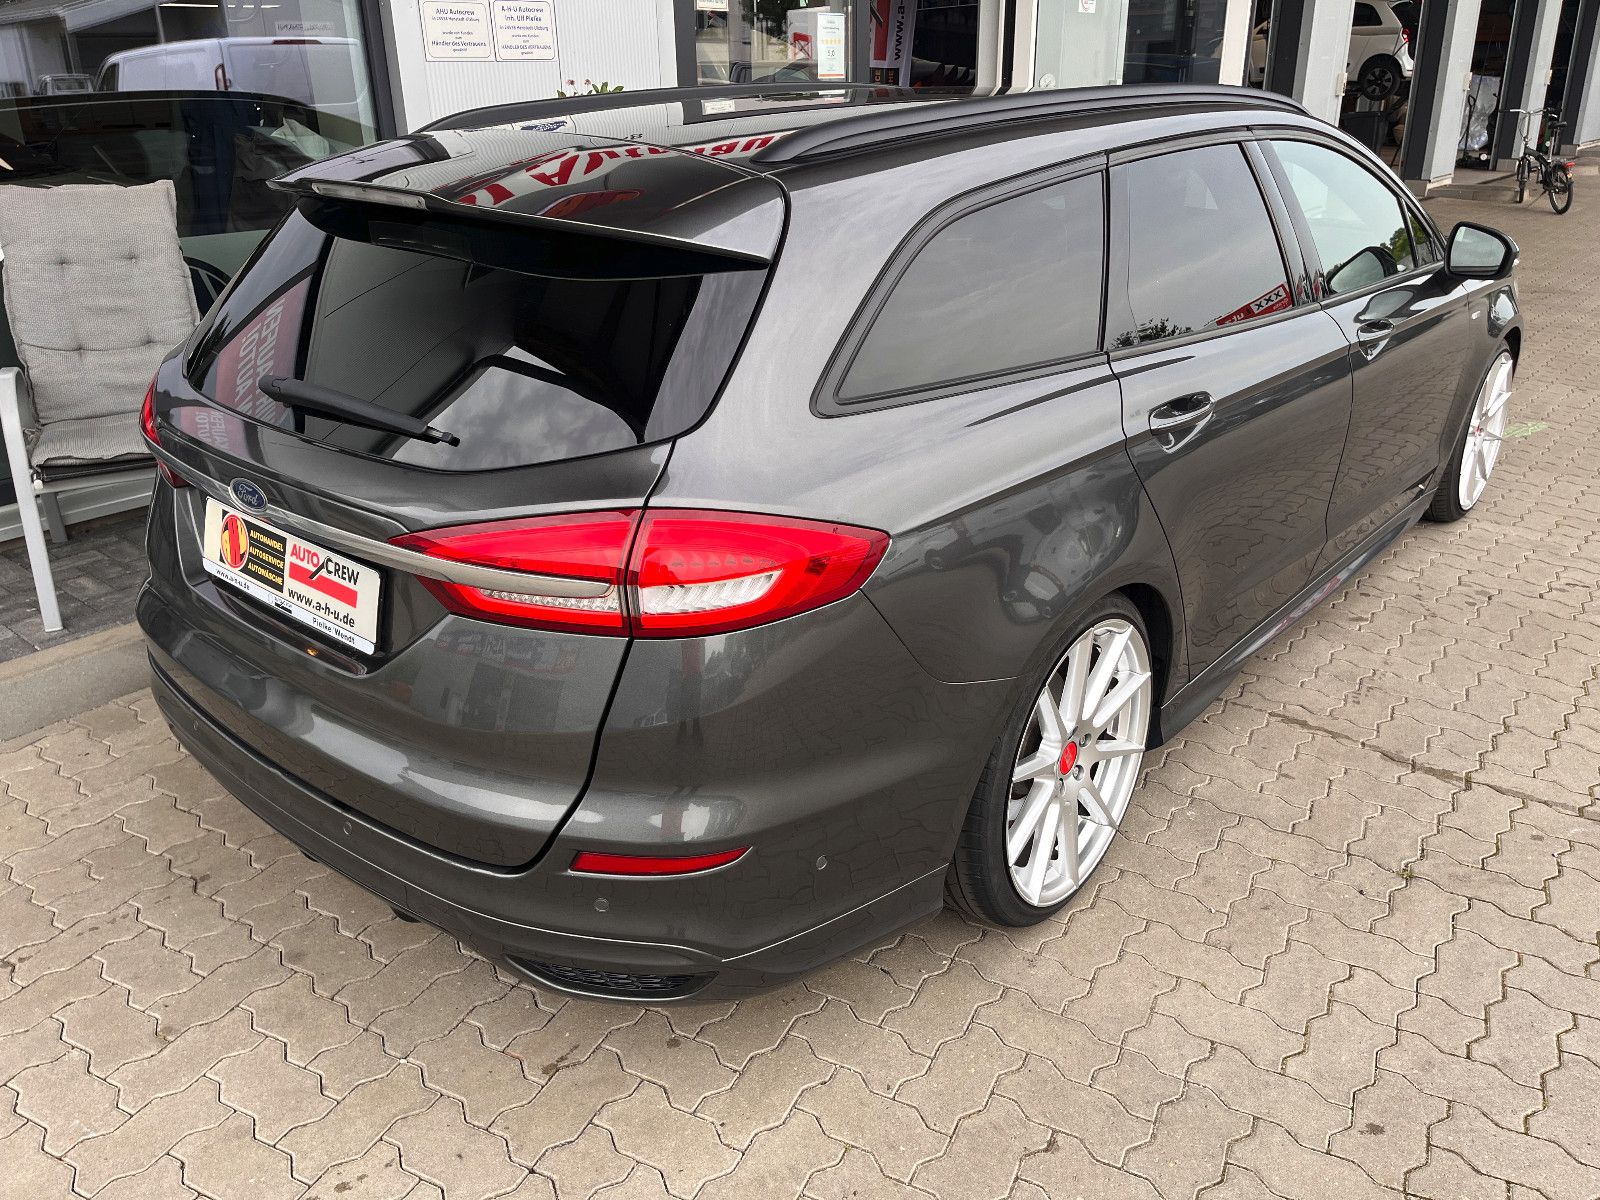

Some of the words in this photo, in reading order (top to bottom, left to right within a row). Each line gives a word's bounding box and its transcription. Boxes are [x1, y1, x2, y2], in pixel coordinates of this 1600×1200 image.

[236, 482, 259, 507] Ford
[249, 529, 284, 552] AUTOHANDEL
[249, 545, 284, 570] AUTOSERVICE
[287, 587, 355, 628] www.a-h-u.de
